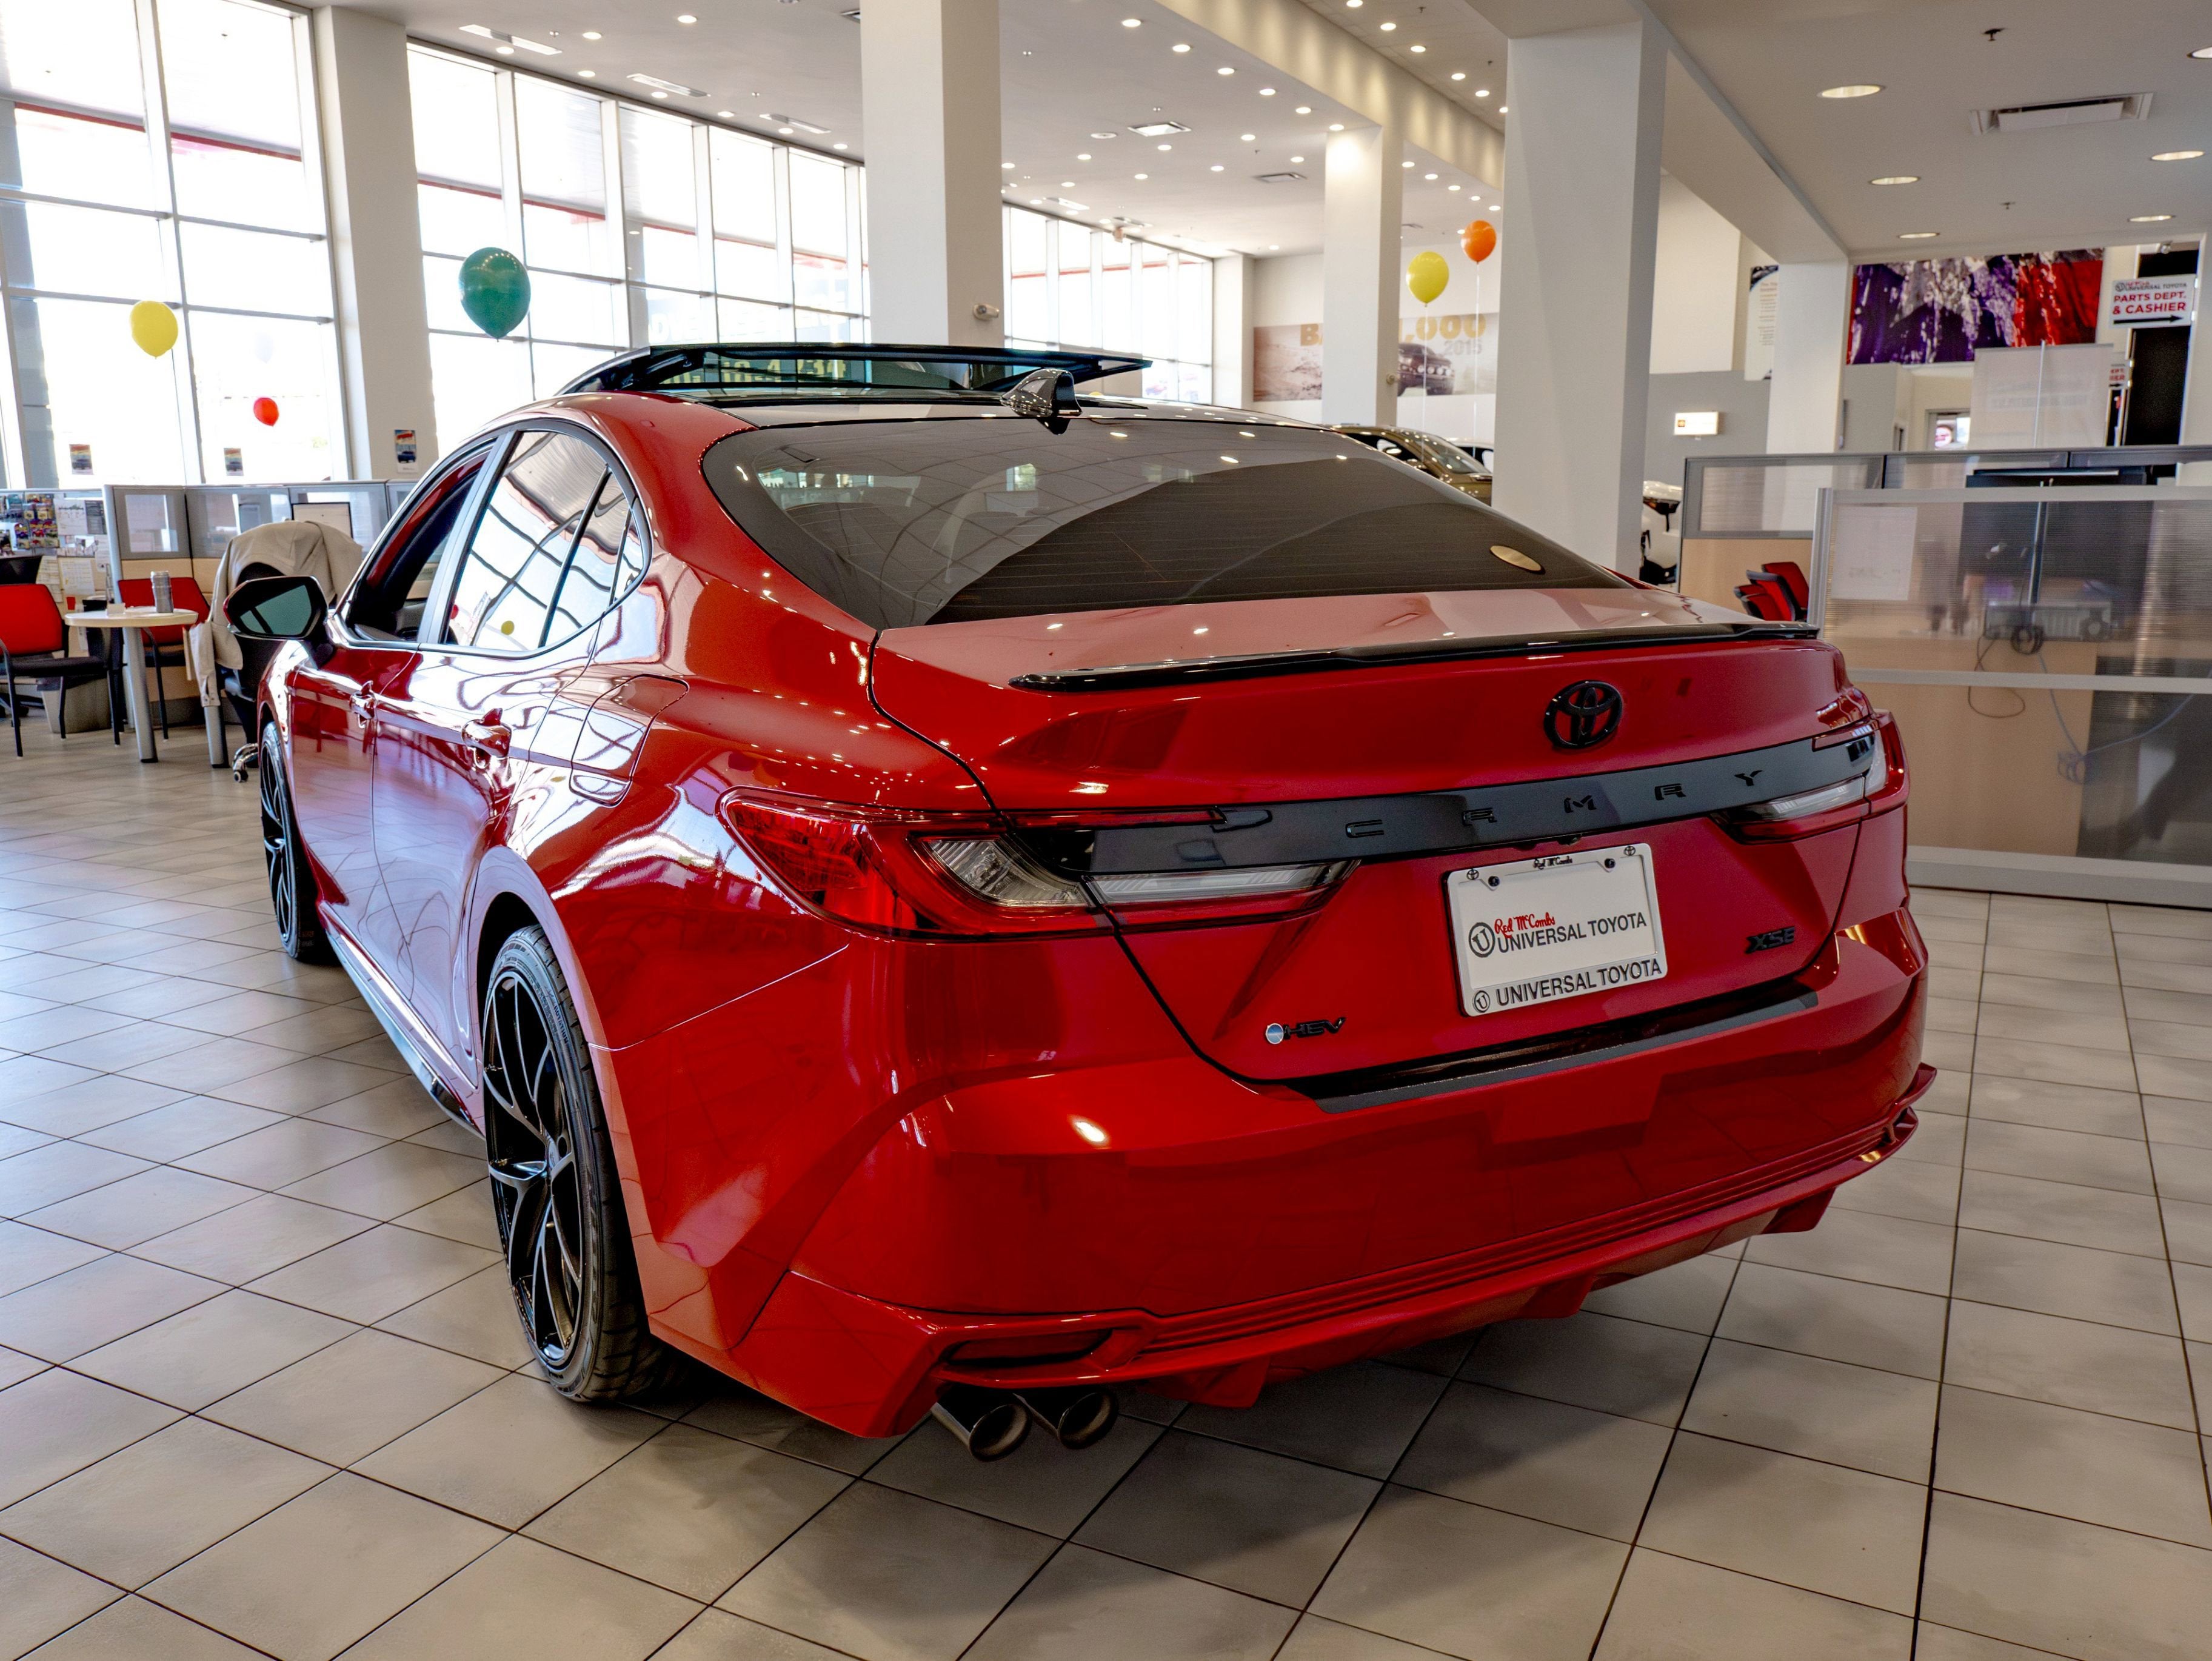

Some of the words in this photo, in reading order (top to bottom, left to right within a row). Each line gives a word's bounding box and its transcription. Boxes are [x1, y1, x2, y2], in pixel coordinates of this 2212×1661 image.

[2113, 292, 2150, 302] PARTS
[2154, 291, 2187, 301] DEPT.
[2113, 305, 2121, 315] &
[2125, 302, 2186, 314] CASHIER
[1345, 770, 1763, 838] CAMRY
[1494, 917, 1514, 939] Red
[1512, 912, 1555, 931] McCombs
[1497, 923, 1587, 953] UNIVERSAL
[1587, 912, 1648, 937] TOYOTA
[1744, 926, 1796, 954] XSE
[1495, 971, 1597, 1006] UNIVERSAL
[1597, 958, 1662, 986] TOYOTA
